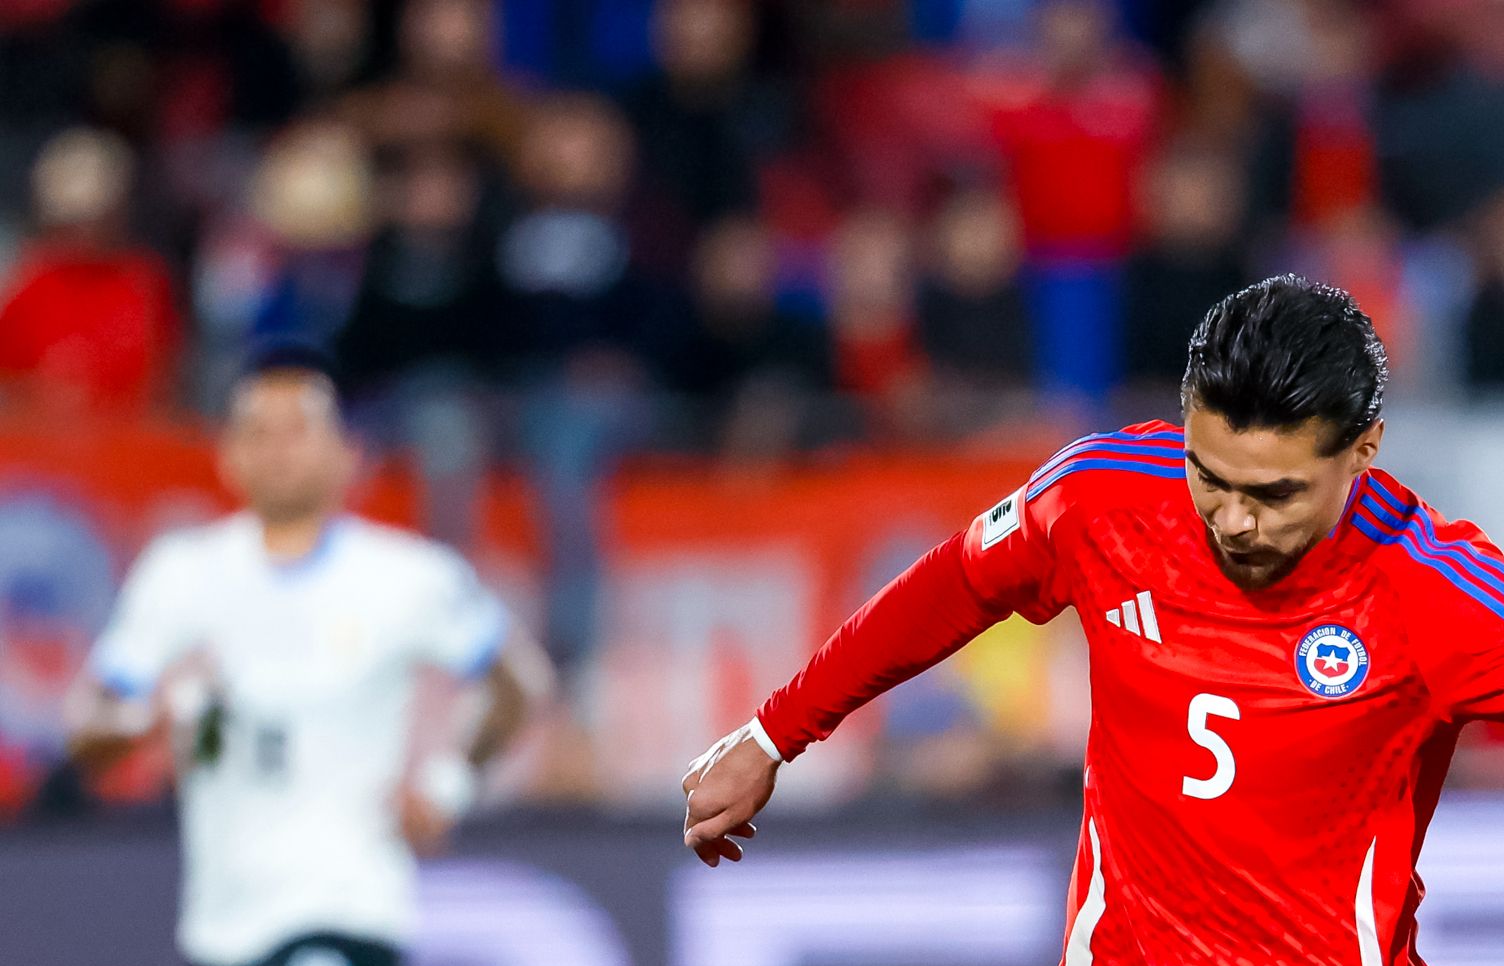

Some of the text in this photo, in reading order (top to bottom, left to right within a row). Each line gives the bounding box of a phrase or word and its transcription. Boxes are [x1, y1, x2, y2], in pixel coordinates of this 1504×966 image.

[1340, 629, 1352, 641] DE
[1310, 682, 1346, 695] DE CHILE
[1181, 692, 1241, 800] 5
